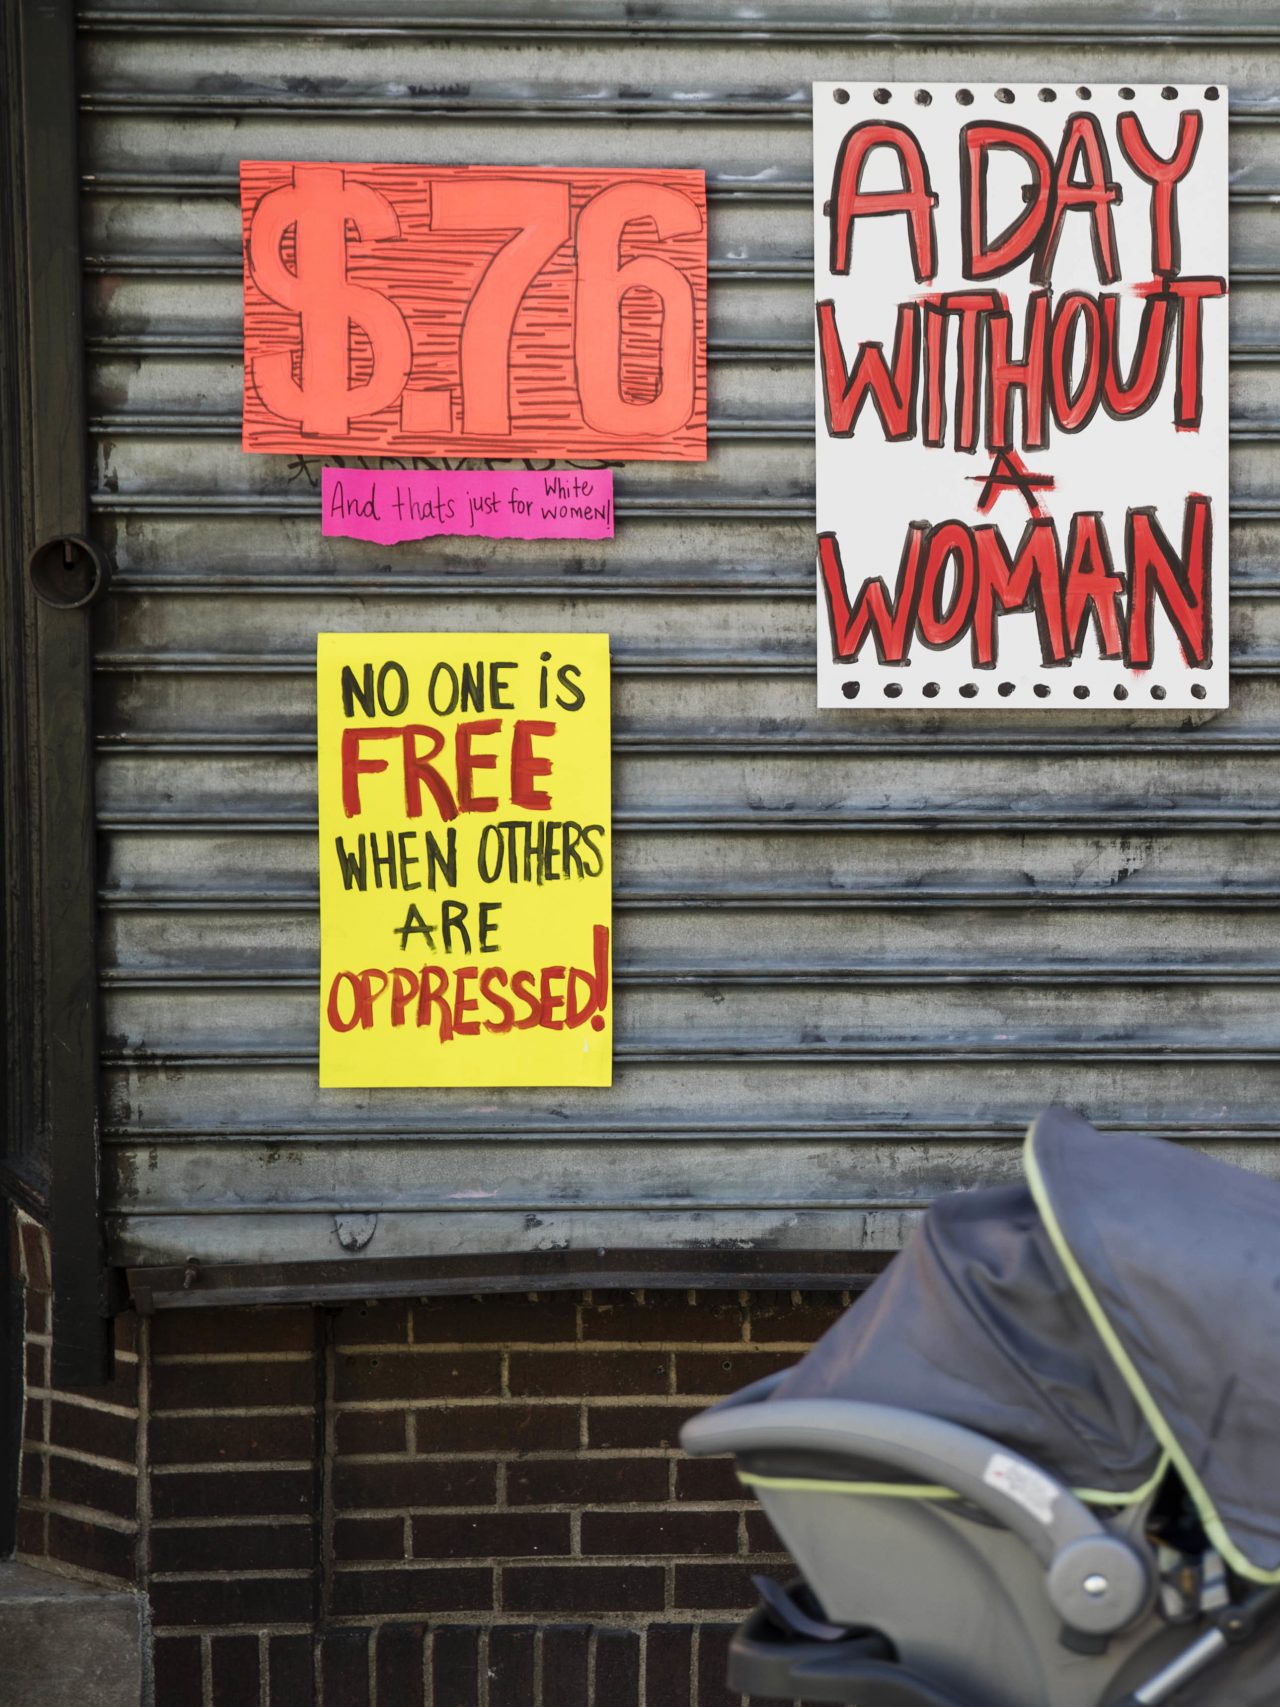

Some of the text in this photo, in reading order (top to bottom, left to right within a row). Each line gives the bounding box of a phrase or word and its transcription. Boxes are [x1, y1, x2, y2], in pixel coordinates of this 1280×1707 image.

[823, 109, 1204, 285] A DAY
[248, 165, 704, 437] $.76
[816, 275, 1228, 454] WITHOUT
[331, 476, 594, 528] And thats just for White
[964, 448, 1057, 520] A
[817, 492, 1214, 672] WOMAN
[341, 661, 409, 718] NO
[428, 661, 519, 717] ONE
[341, 718, 556, 822] FREE
[335, 821, 605, 892] WHEN OTHERS
[393, 900, 503, 955] ARE
[327, 924, 609, 1044] OPPRESSED!
